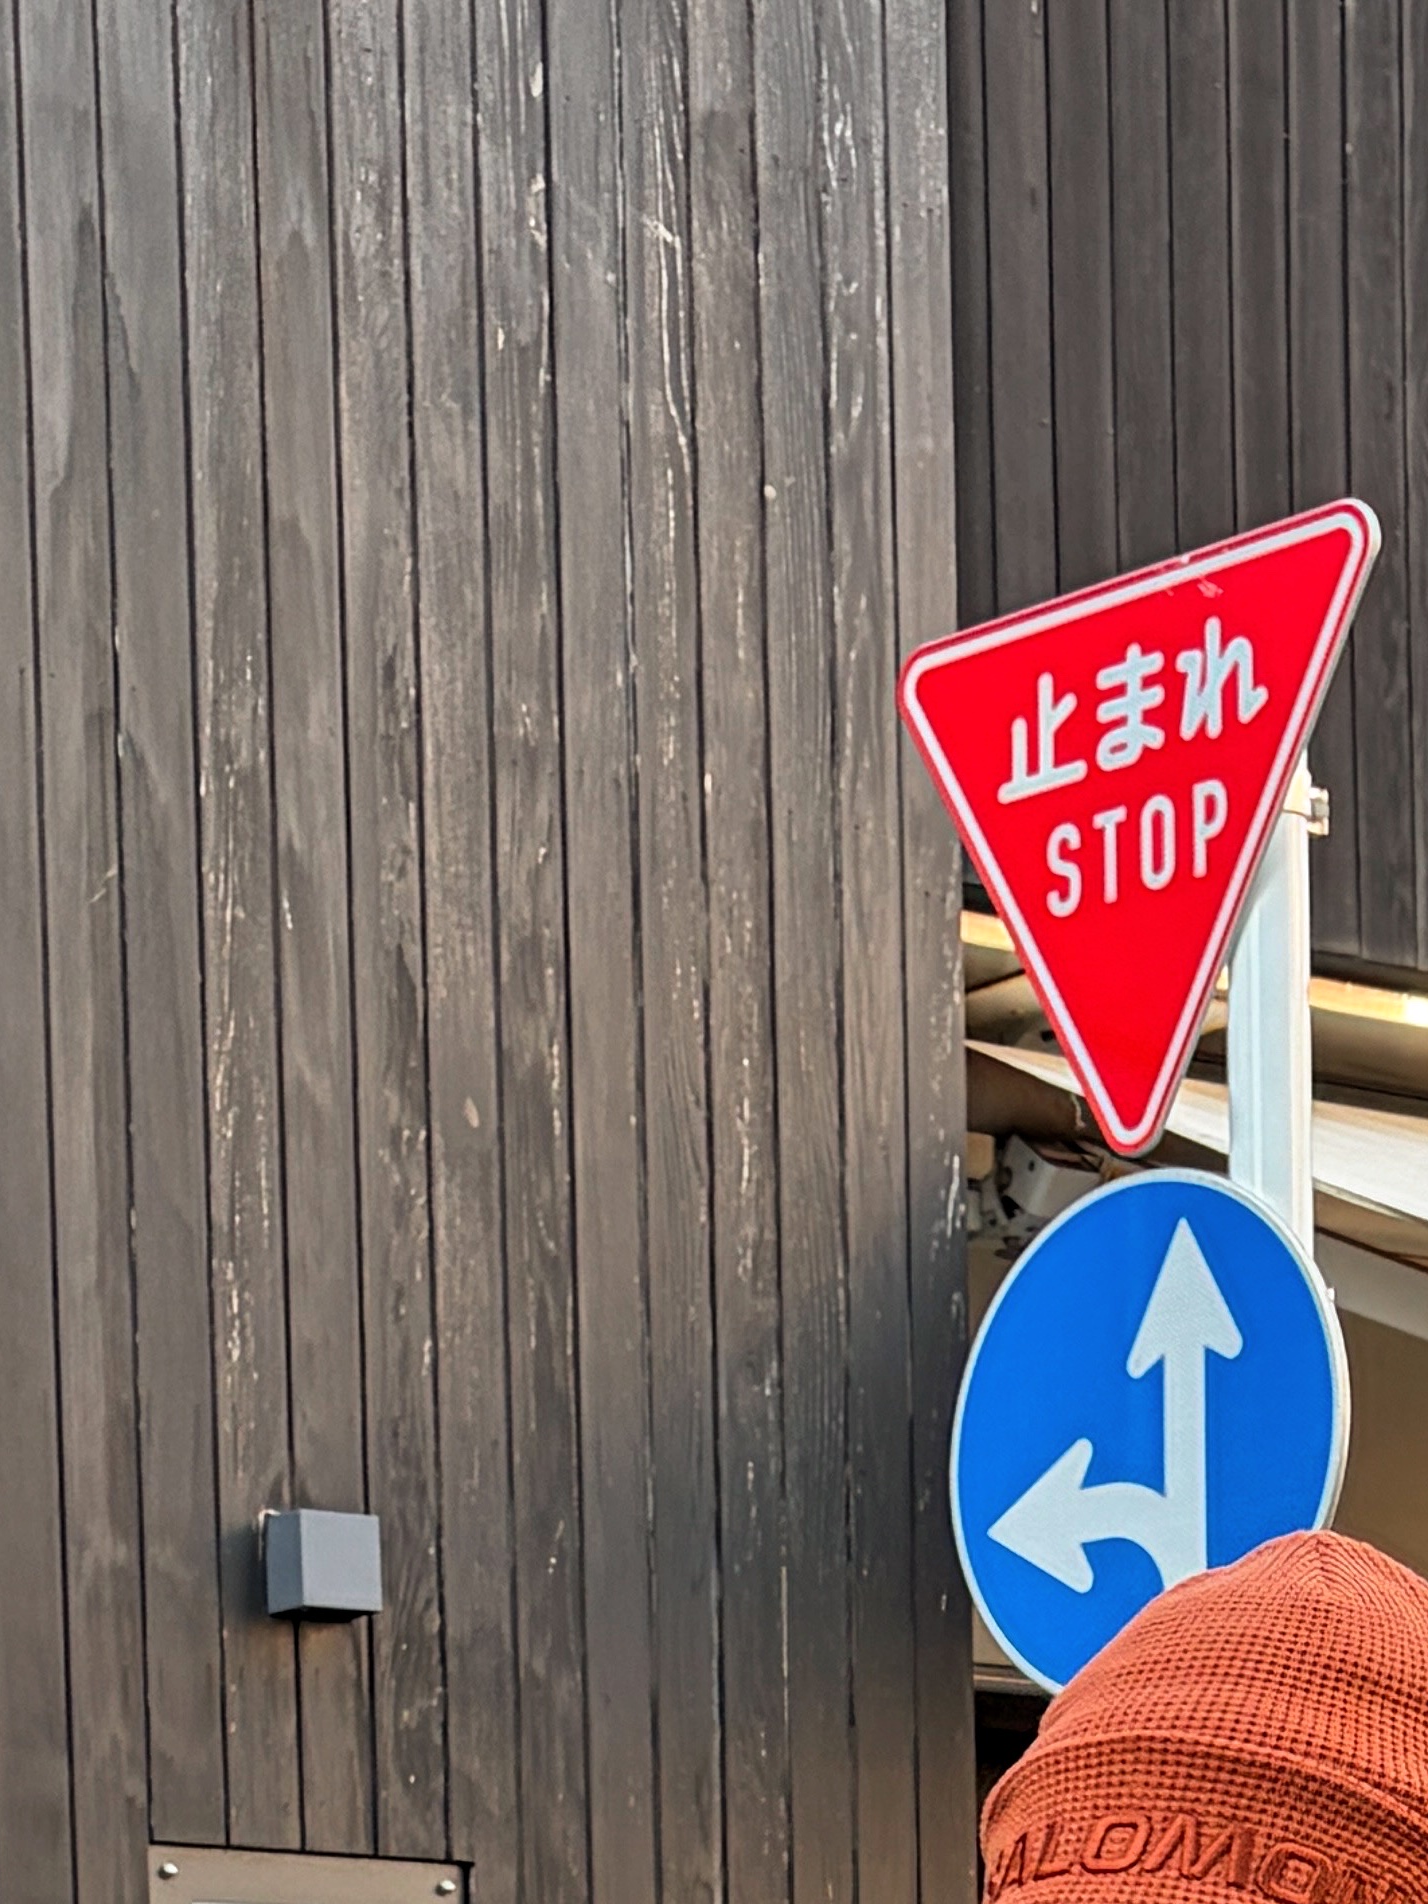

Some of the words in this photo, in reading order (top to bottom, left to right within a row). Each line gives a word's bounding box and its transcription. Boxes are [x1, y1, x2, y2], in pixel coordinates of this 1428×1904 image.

[997, 616, 1269, 805] 止まれ
[1045, 778, 1229, 919] STOP
